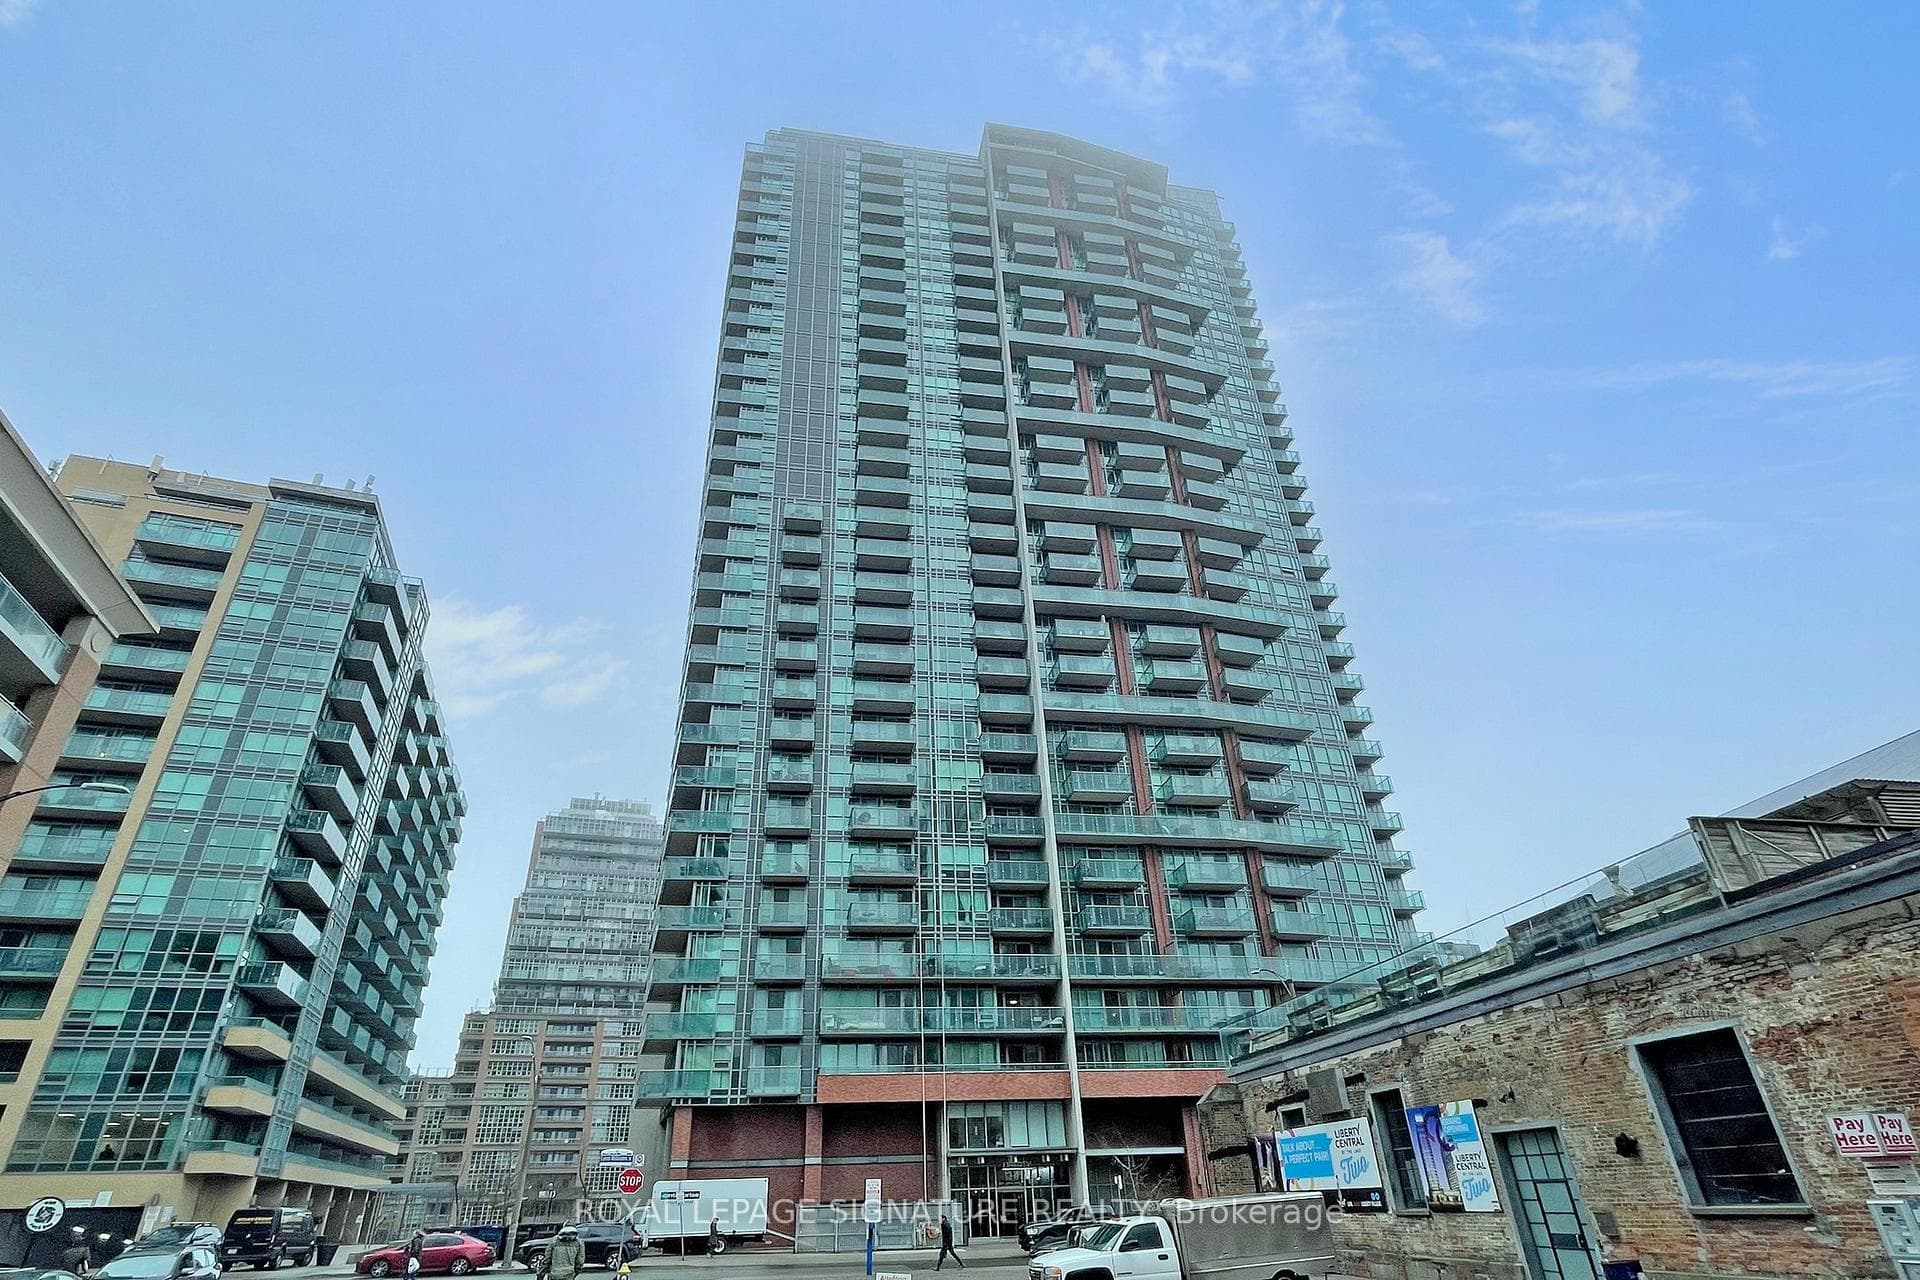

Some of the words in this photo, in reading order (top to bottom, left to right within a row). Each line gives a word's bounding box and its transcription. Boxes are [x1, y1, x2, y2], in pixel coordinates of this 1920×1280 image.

[1334, 1122, 1360, 1139] LIBERTY
[1833, 1117, 1864, 1133] Pay
[1877, 1115, 1903, 1132] Pay
[1334, 1136, 1365, 1149] CENTRAL
[1834, 1132, 1876, 1146] Here
[1881, 1131, 1913, 1145] Here
[1455, 1150, 1481, 1162] LIBERTY
[1340, 1156, 1370, 1184] Two
[1456, 1160, 1486, 1171] CENTRAL
[620, 1176, 641, 1187] STOP
[1461, 1177, 1491, 1201] Two
